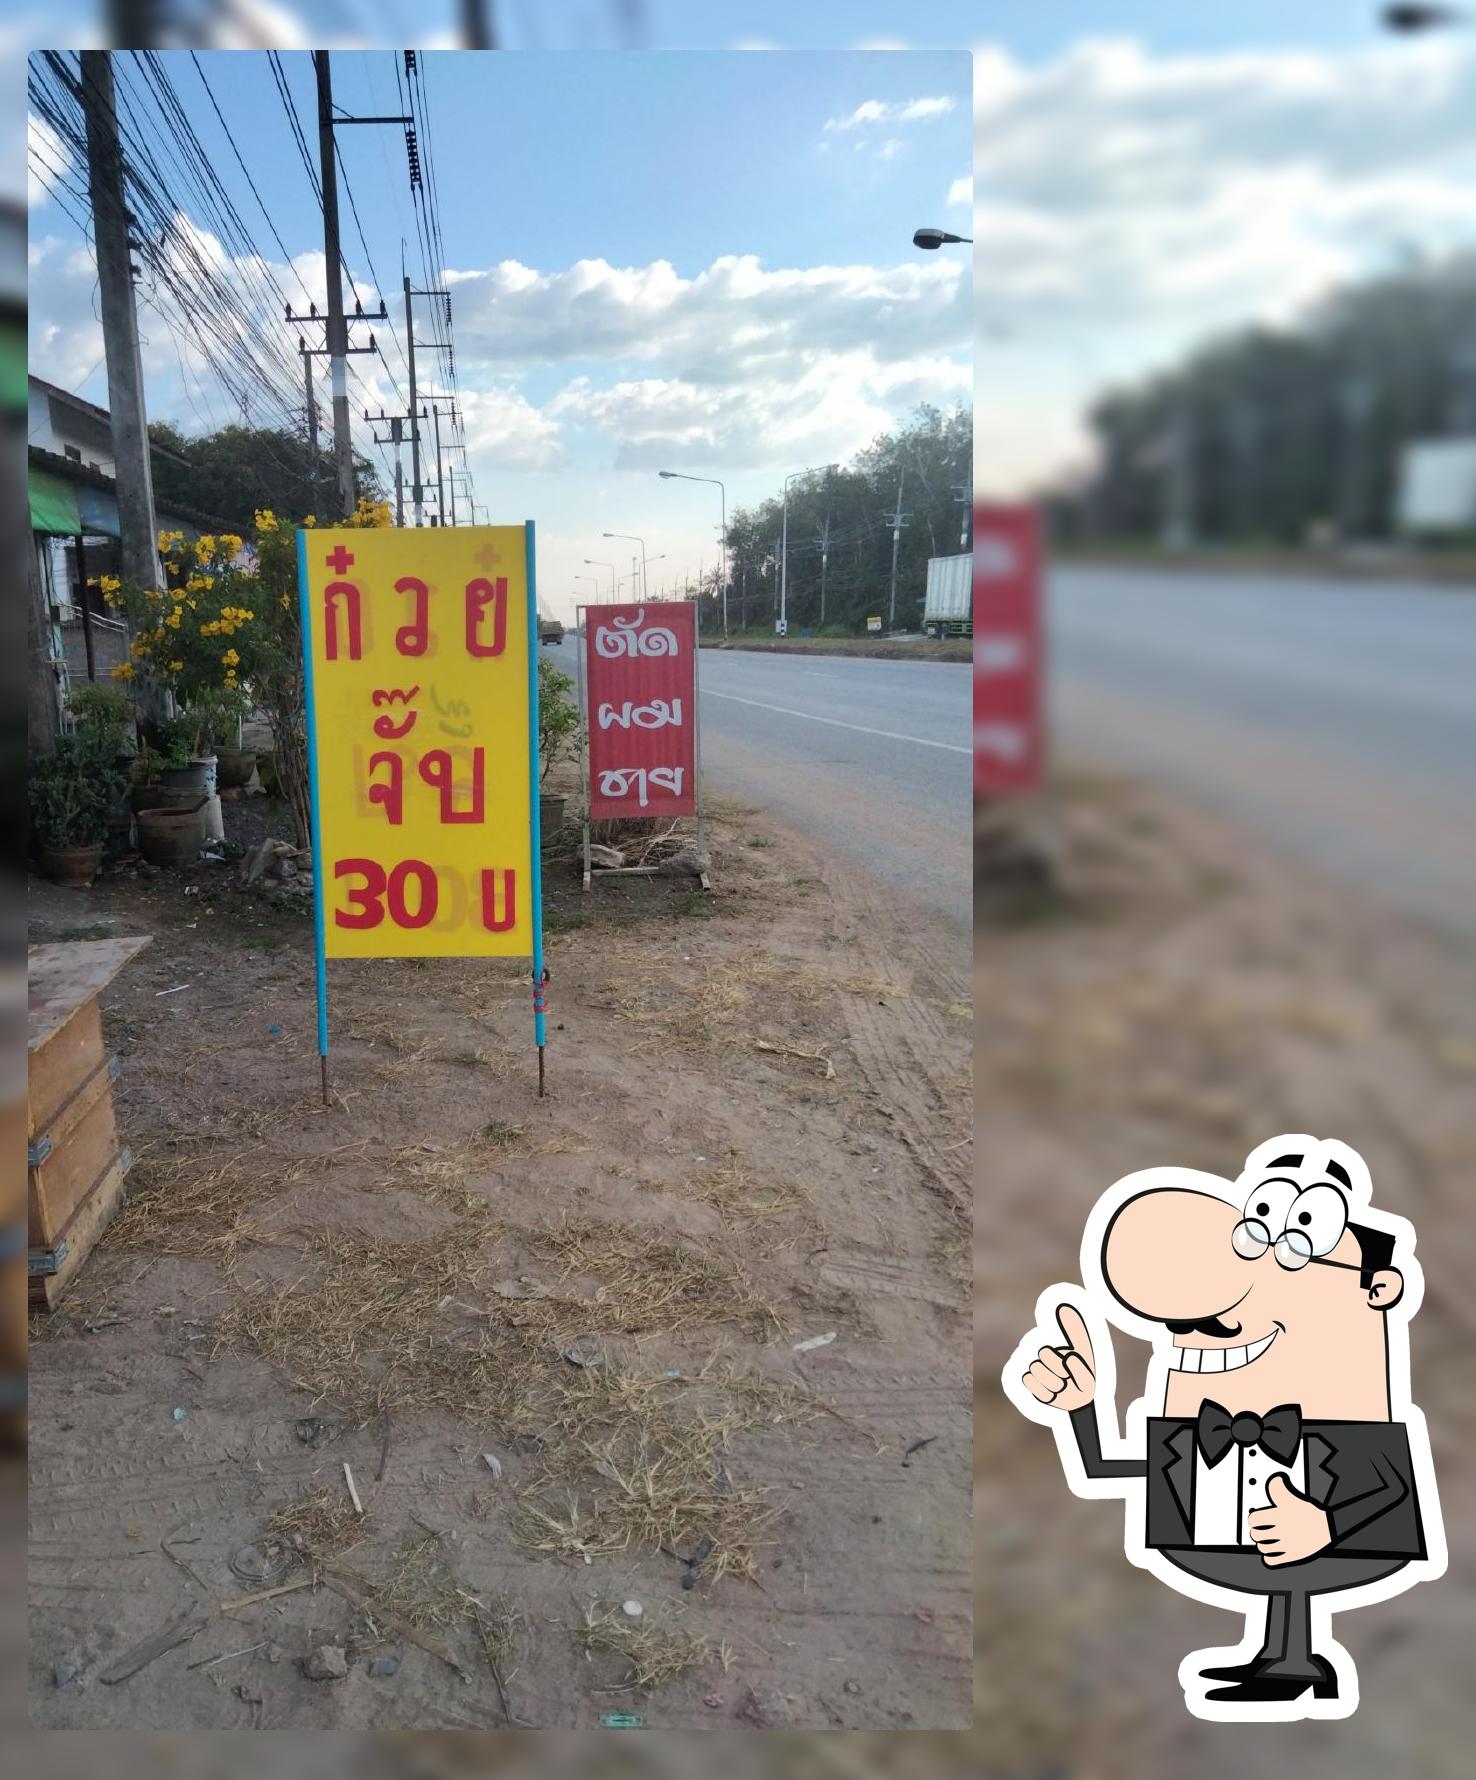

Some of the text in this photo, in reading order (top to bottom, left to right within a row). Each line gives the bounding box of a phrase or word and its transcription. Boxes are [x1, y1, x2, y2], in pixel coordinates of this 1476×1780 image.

[595, 608, 679, 658] ตัด
[598, 698, 682, 730] ผม
[368, 684, 485, 825] จั๊บ
[598, 767, 685, 807] ชาย
[334, 858, 439, 930] 30
